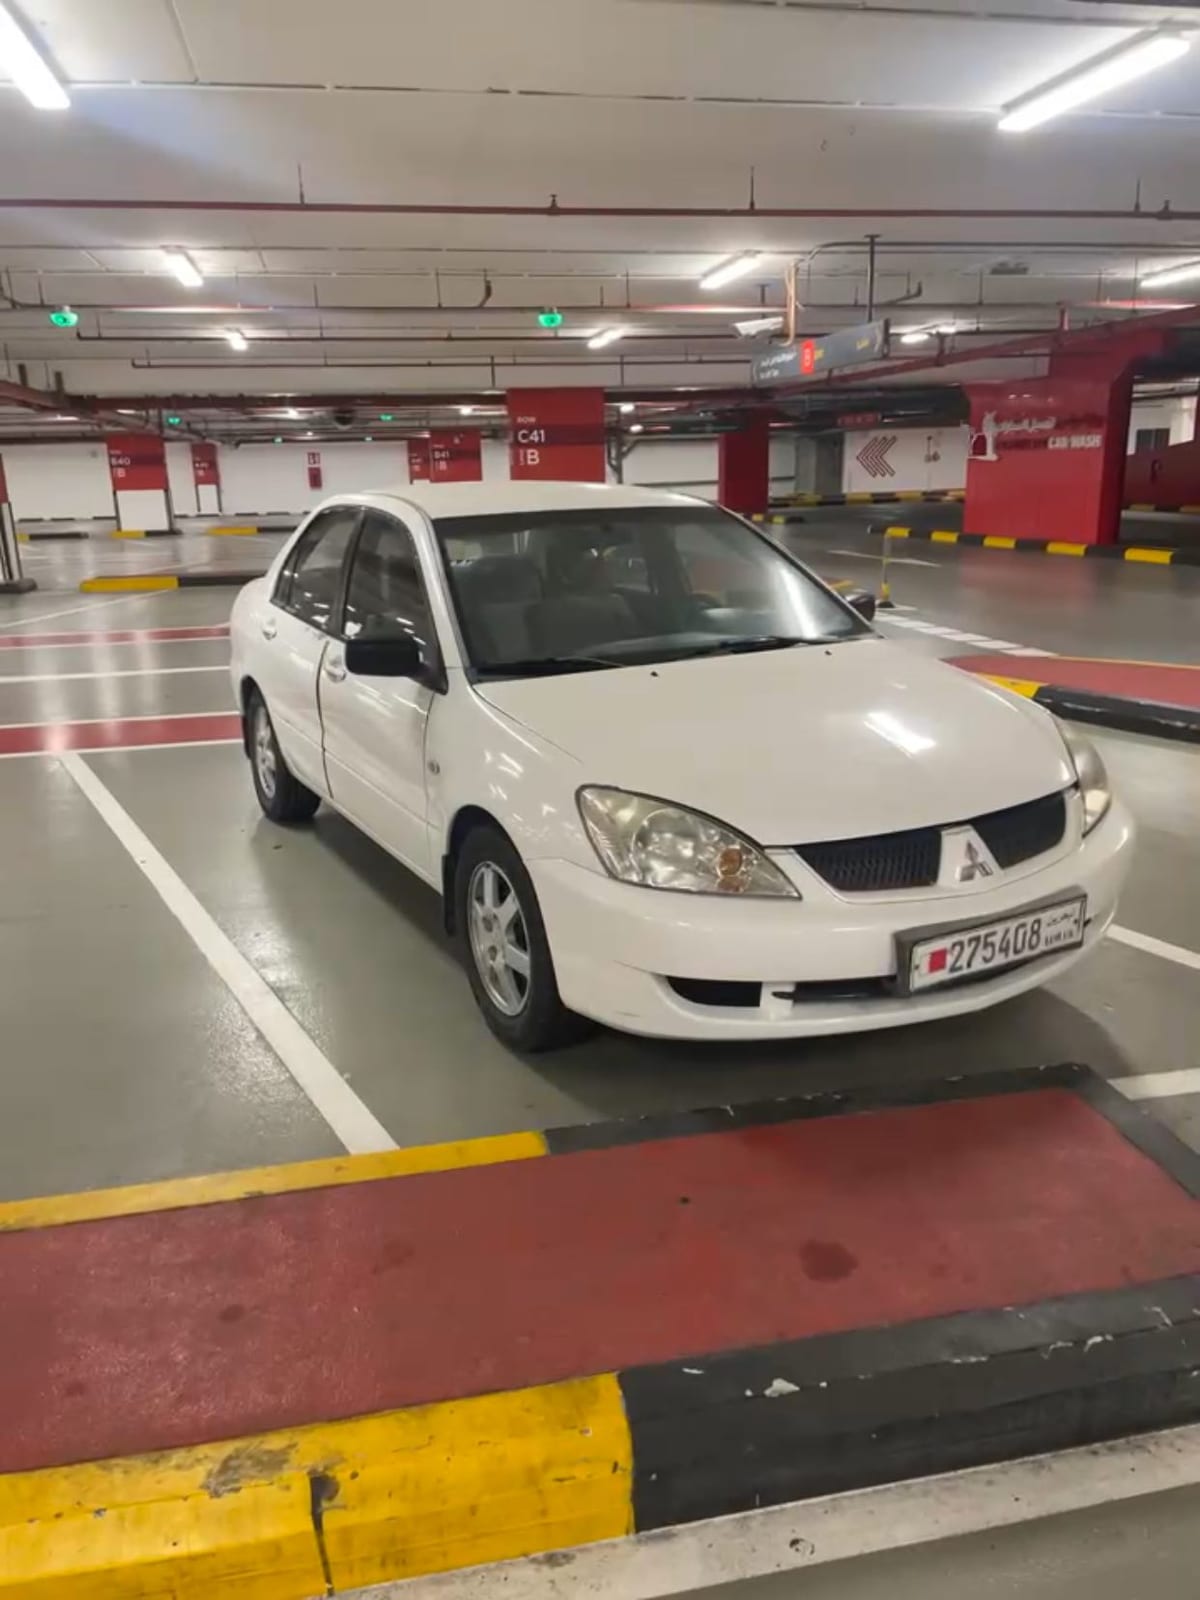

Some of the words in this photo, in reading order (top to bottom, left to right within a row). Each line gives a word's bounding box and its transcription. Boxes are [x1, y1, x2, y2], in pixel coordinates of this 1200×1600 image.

[518, 429, 546, 443] C41
[1046, 435, 1069, 449] CAR
[1070, 434, 1103, 448] WASH
[526, 448, 540, 465] B
[948, 918, 1042, 973] 275408
